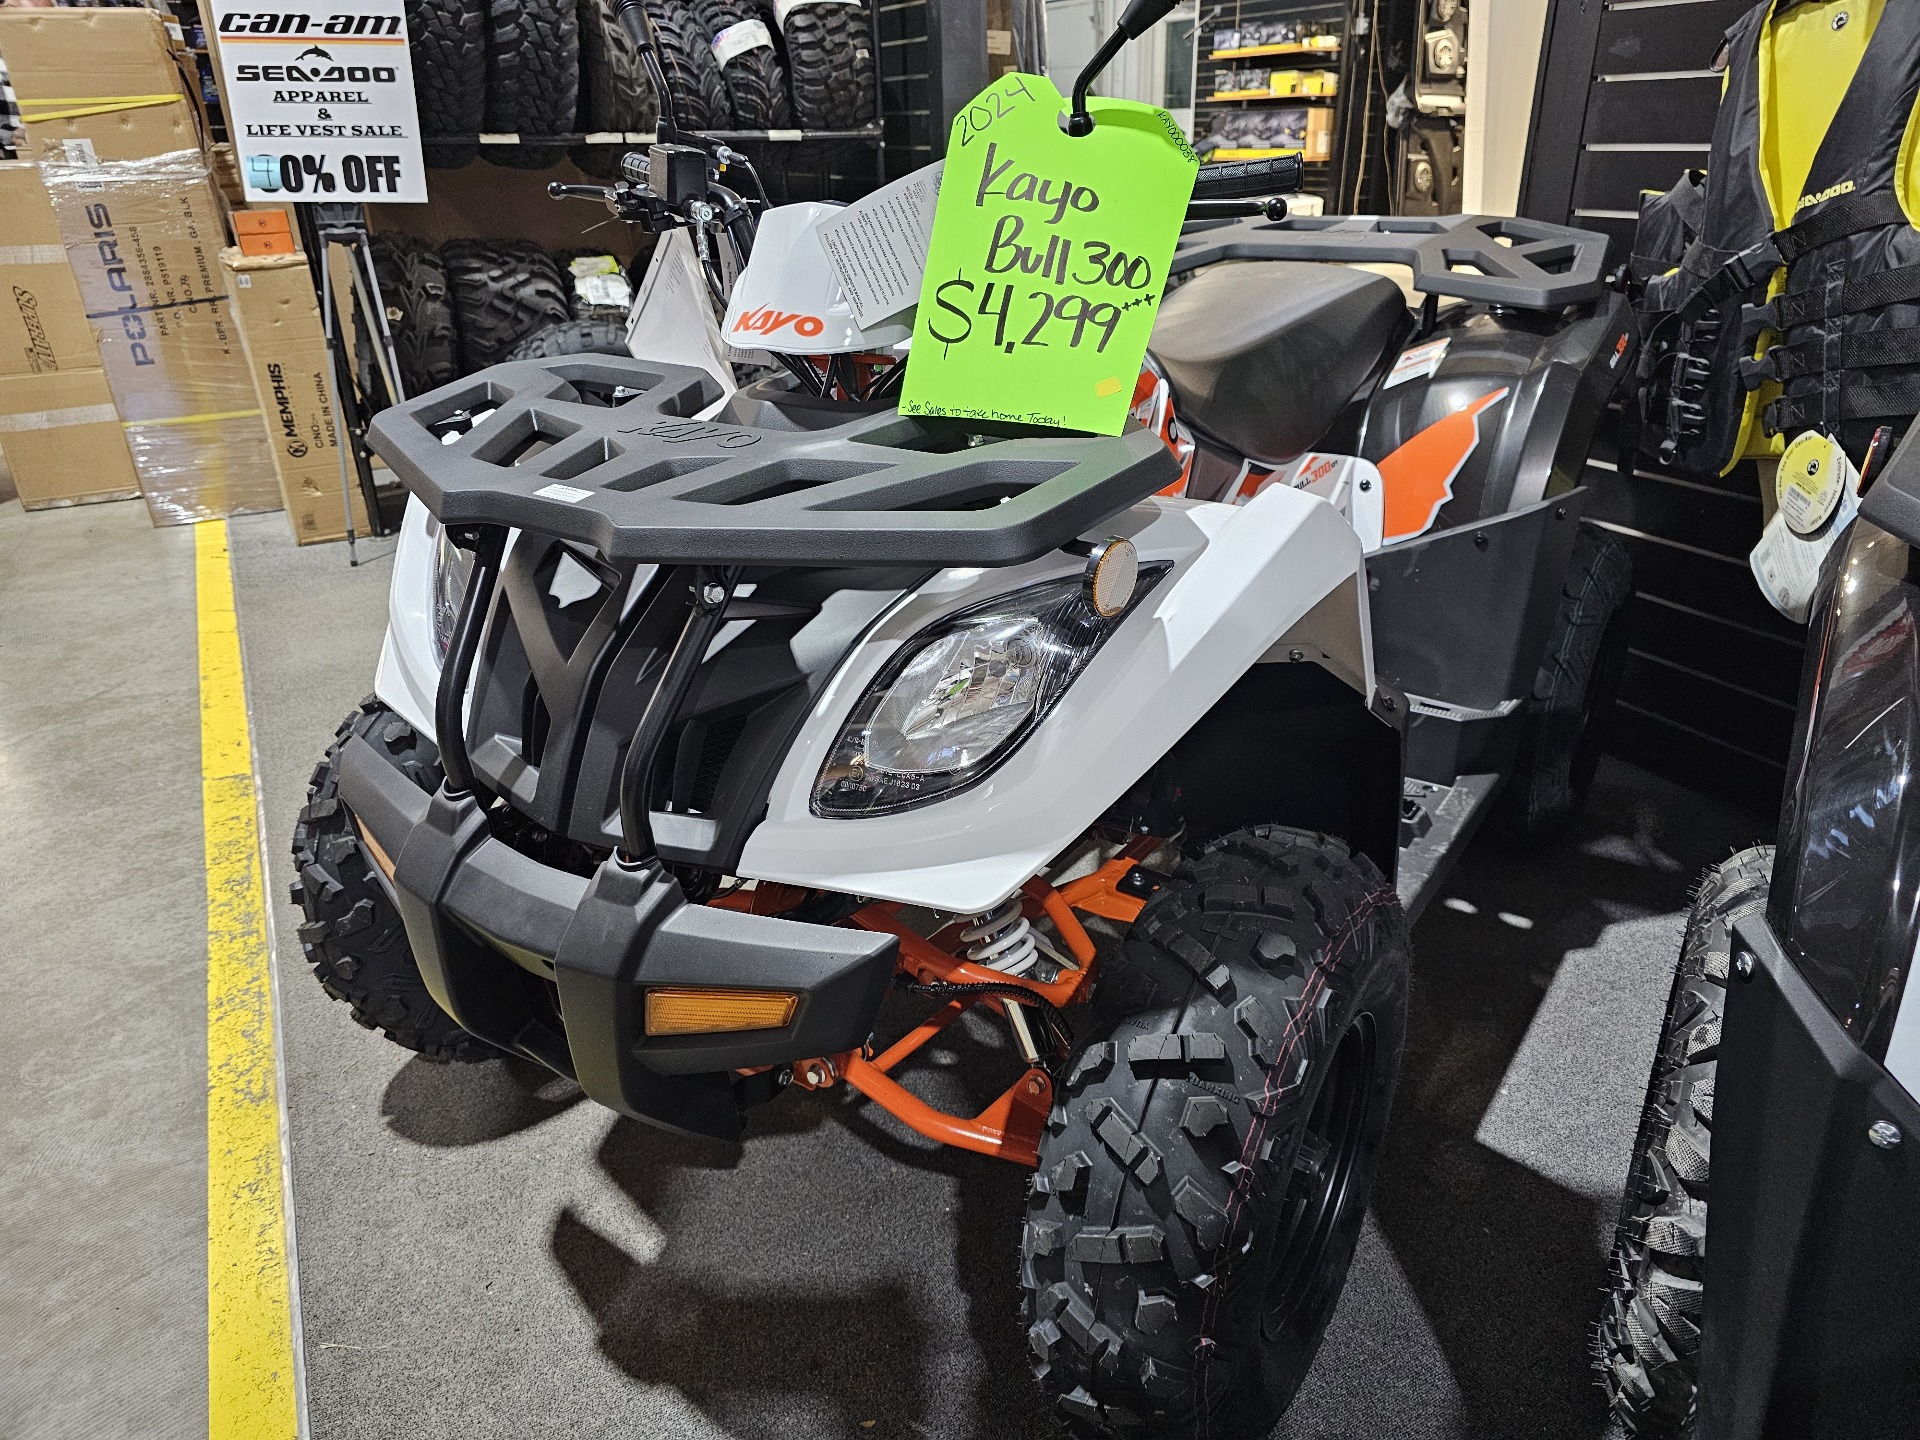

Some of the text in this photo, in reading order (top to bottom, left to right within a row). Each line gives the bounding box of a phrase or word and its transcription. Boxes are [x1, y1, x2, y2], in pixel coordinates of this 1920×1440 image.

[273, 90, 369, 103] APPAREL
[956, 76, 1035, 147] 2024
[318, 107, 332, 120] &
[246, 124, 402, 137] LIFE VEST SALE
[342, 154, 400, 193] OFF
[975, 142, 1100, 225] Kayo
[85, 203, 155, 367] POLARIS
[155, 311, 170, 336] PART
[732, 301, 824, 337] KAYO
[267, 363, 298, 438] MEMPHIS
[313, 372, 328, 403] CHINA
[321, 405, 332, 417] IN
[924, 400, 947, 417] Sales
[950, 405, 961, 417] to
[963, 406, 989, 419] take
[991, 409, 1023, 422] home
[1027, 412, 1066, 427] Today!
[325, 418, 339, 447] MADE
